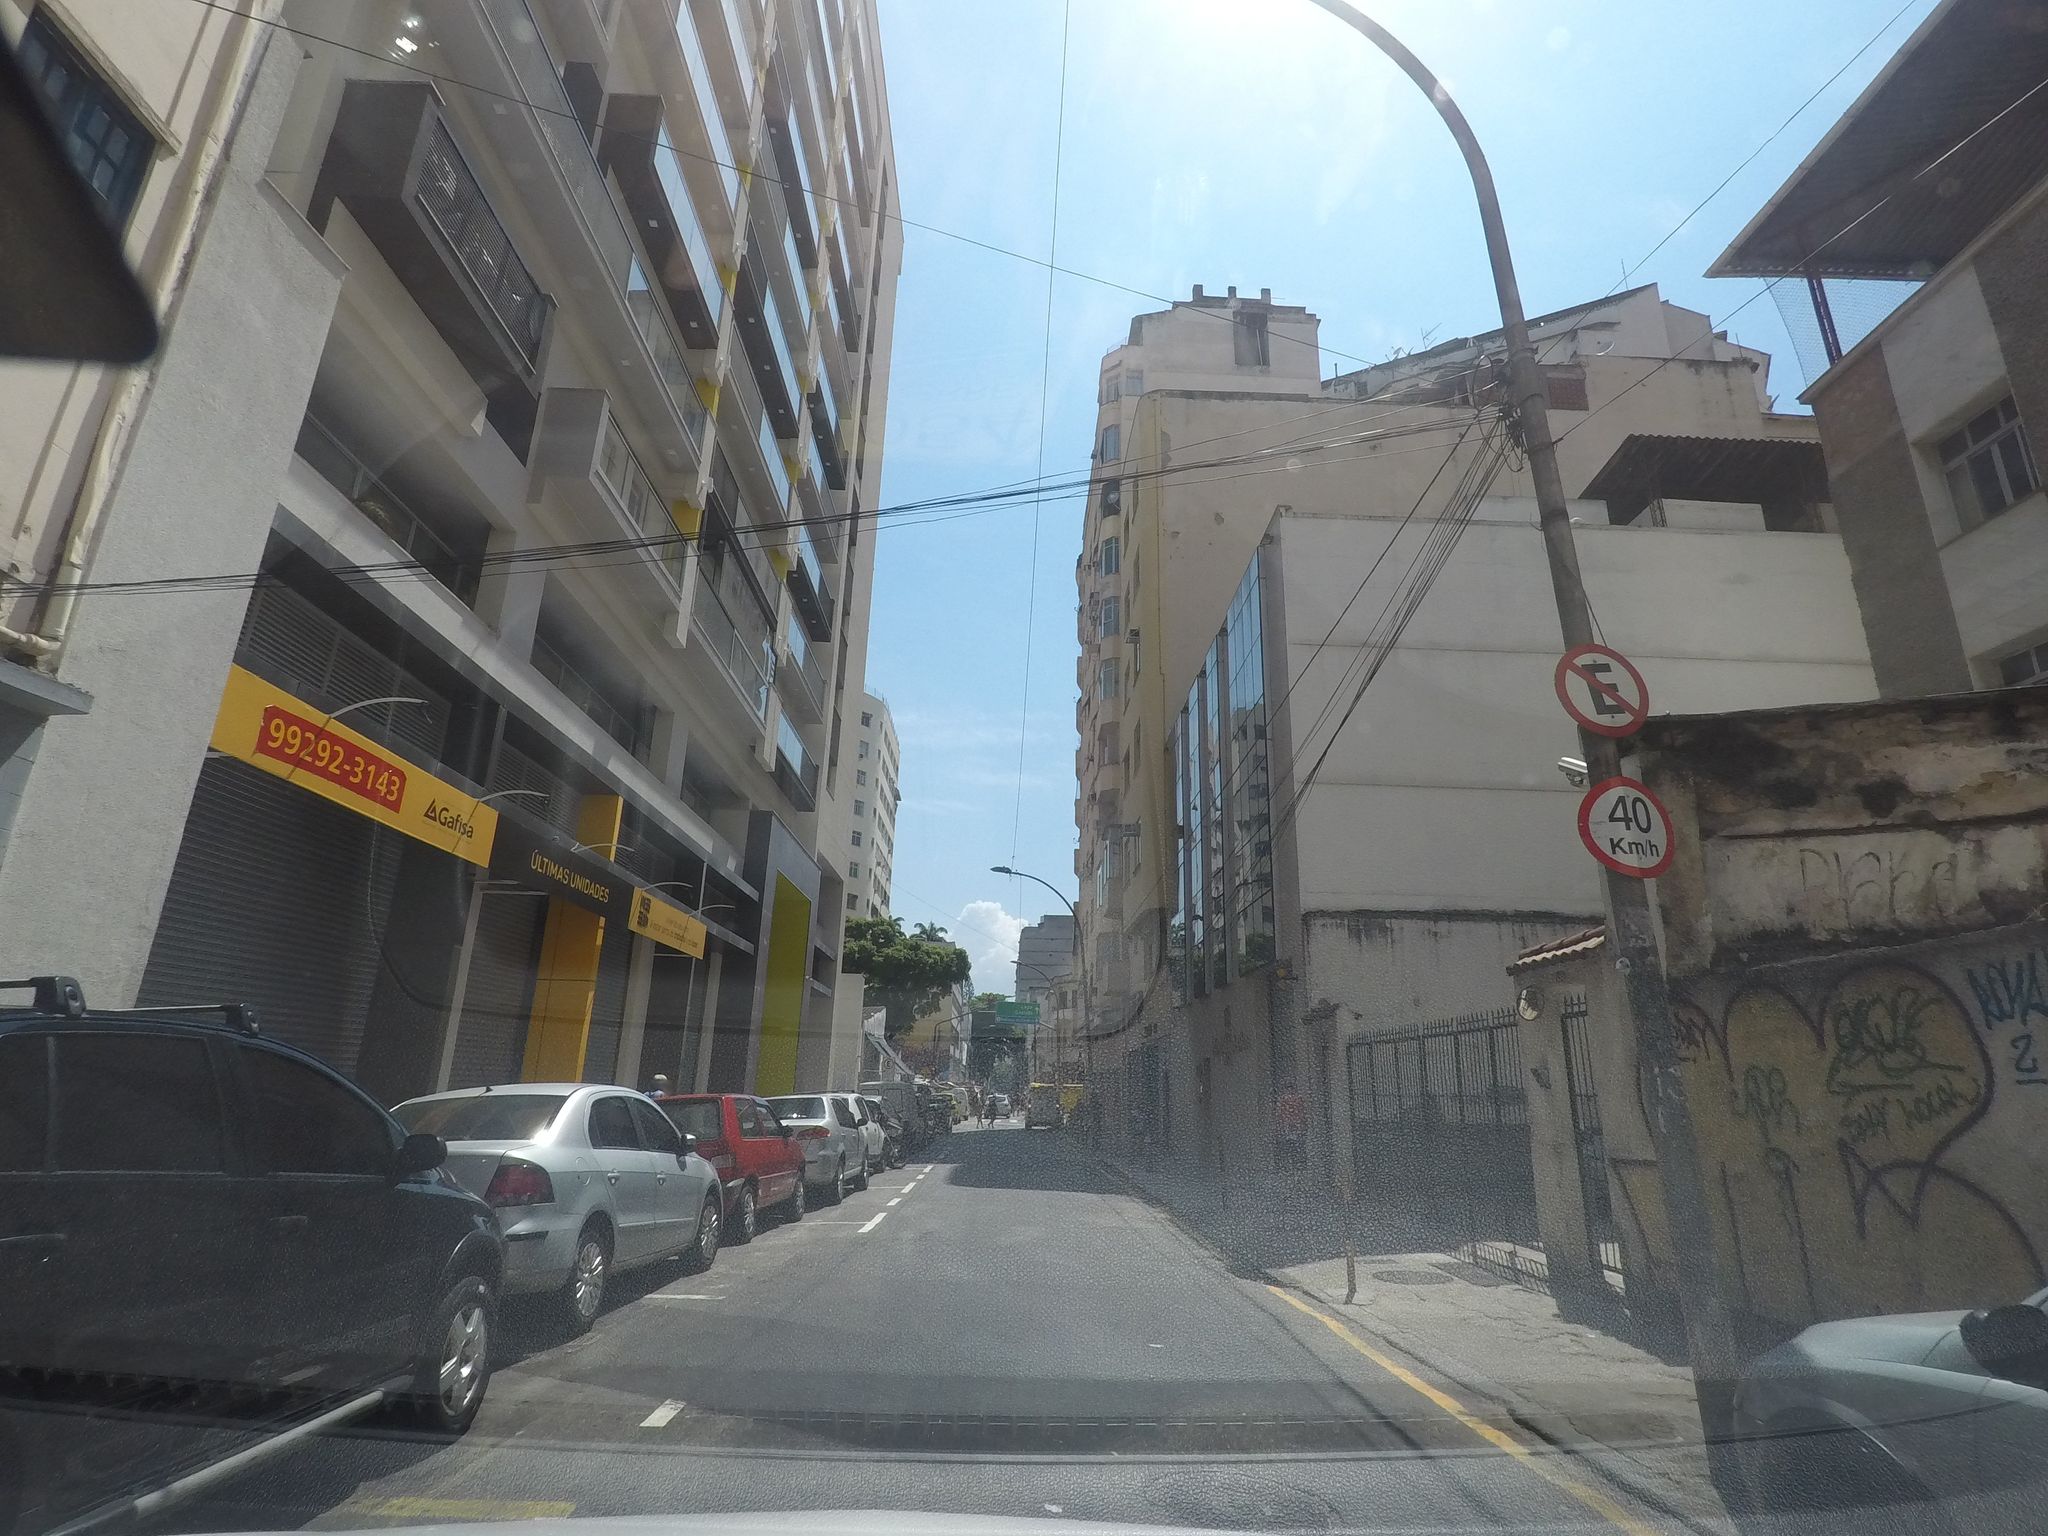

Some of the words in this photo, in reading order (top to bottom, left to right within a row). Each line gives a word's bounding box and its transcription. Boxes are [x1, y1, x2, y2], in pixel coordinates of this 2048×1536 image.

[1581, 663, 1627, 716] E
[267, 718, 401, 801] 99292-3143
[438, 807, 475, 839] Gafisa
[1609, 796, 1652, 834] 40
[1609, 837, 1661, 858] Km/h
[531, 849, 569, 885] ÚLTIMAS
[570, 871, 610, 904] UNIDADES
